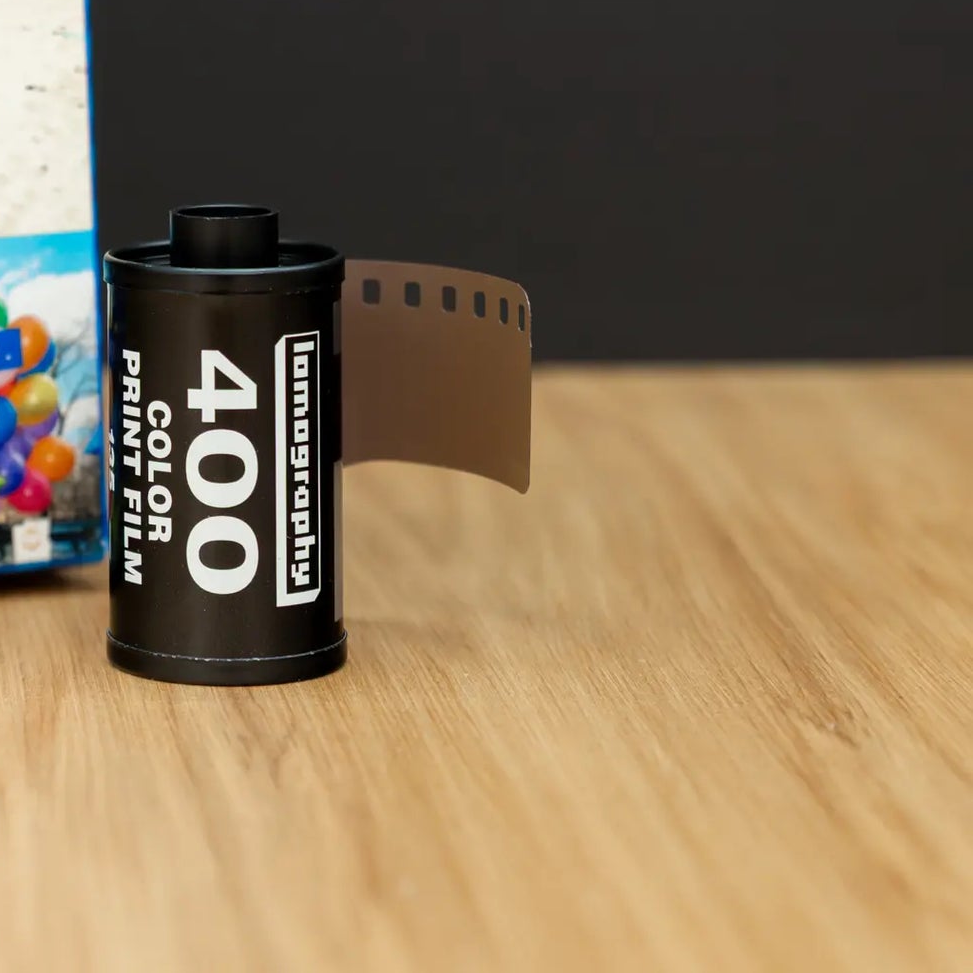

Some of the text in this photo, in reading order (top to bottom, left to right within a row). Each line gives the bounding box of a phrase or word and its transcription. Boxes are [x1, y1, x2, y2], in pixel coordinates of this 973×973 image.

[122, 348, 143, 586] PRINT FILM
[146, 400, 173, 543] COLOR
[185, 349, 259, 595] 400
[290, 340, 316, 586] lomography
